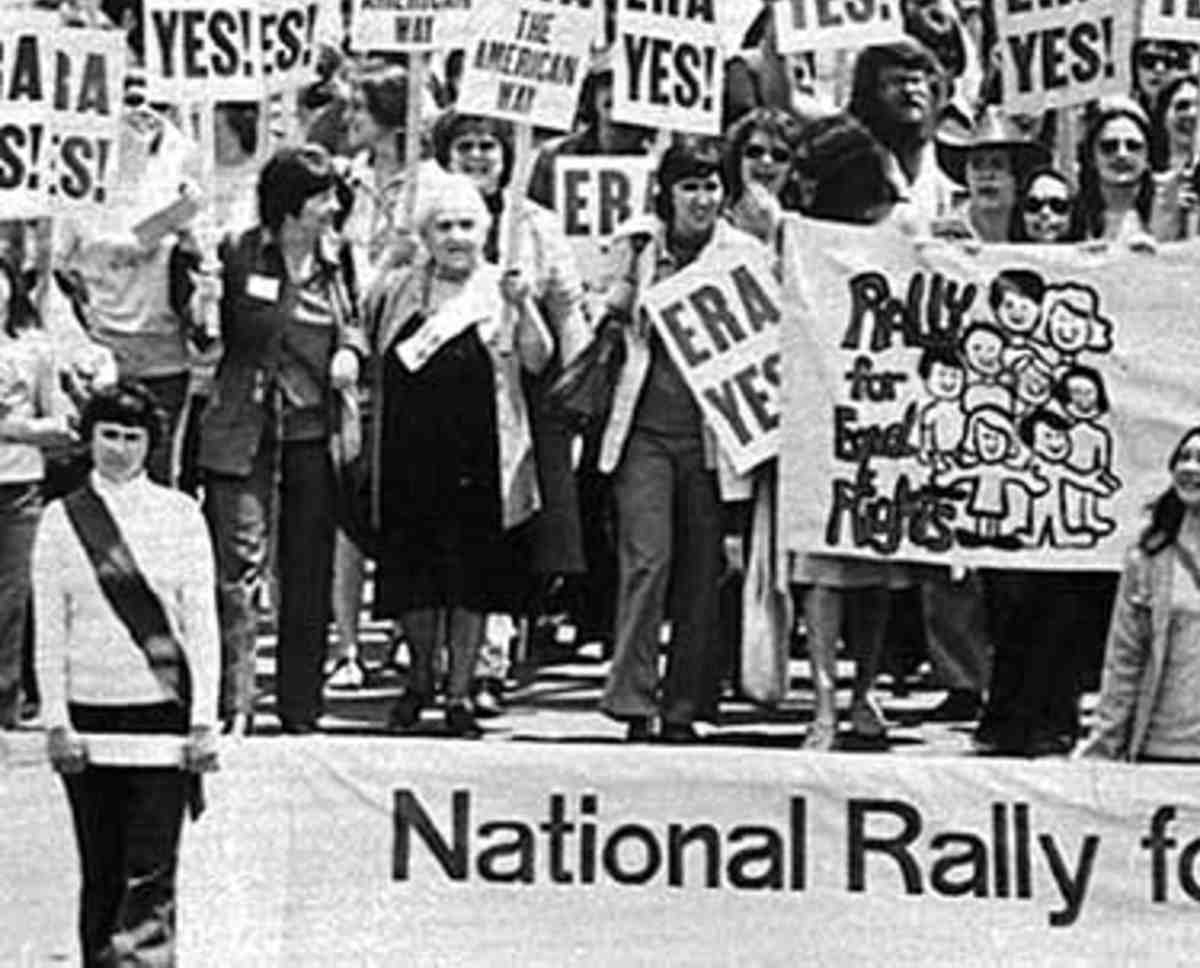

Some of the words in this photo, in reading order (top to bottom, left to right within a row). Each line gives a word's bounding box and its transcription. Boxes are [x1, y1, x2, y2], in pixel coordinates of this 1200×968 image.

[150, 8, 255, 78] YES!
[395, 16, 434, 44] WAY
[473, 38, 582, 87] AMERICAN
[515, 9, 556, 45] THE
[1007, 16, 1116, 94] YES!
[623, 32, 717, 112] YES!
[659, 263, 782, 369] ERA
[841, 271, 978, 353] Rally
[844, 354, 908, 401] for
[834, 401, 921, 461] Equal
[826, 466, 974, 553] Rights
[390, 789, 807, 891] National
[845, 797, 1101, 928] Rally
